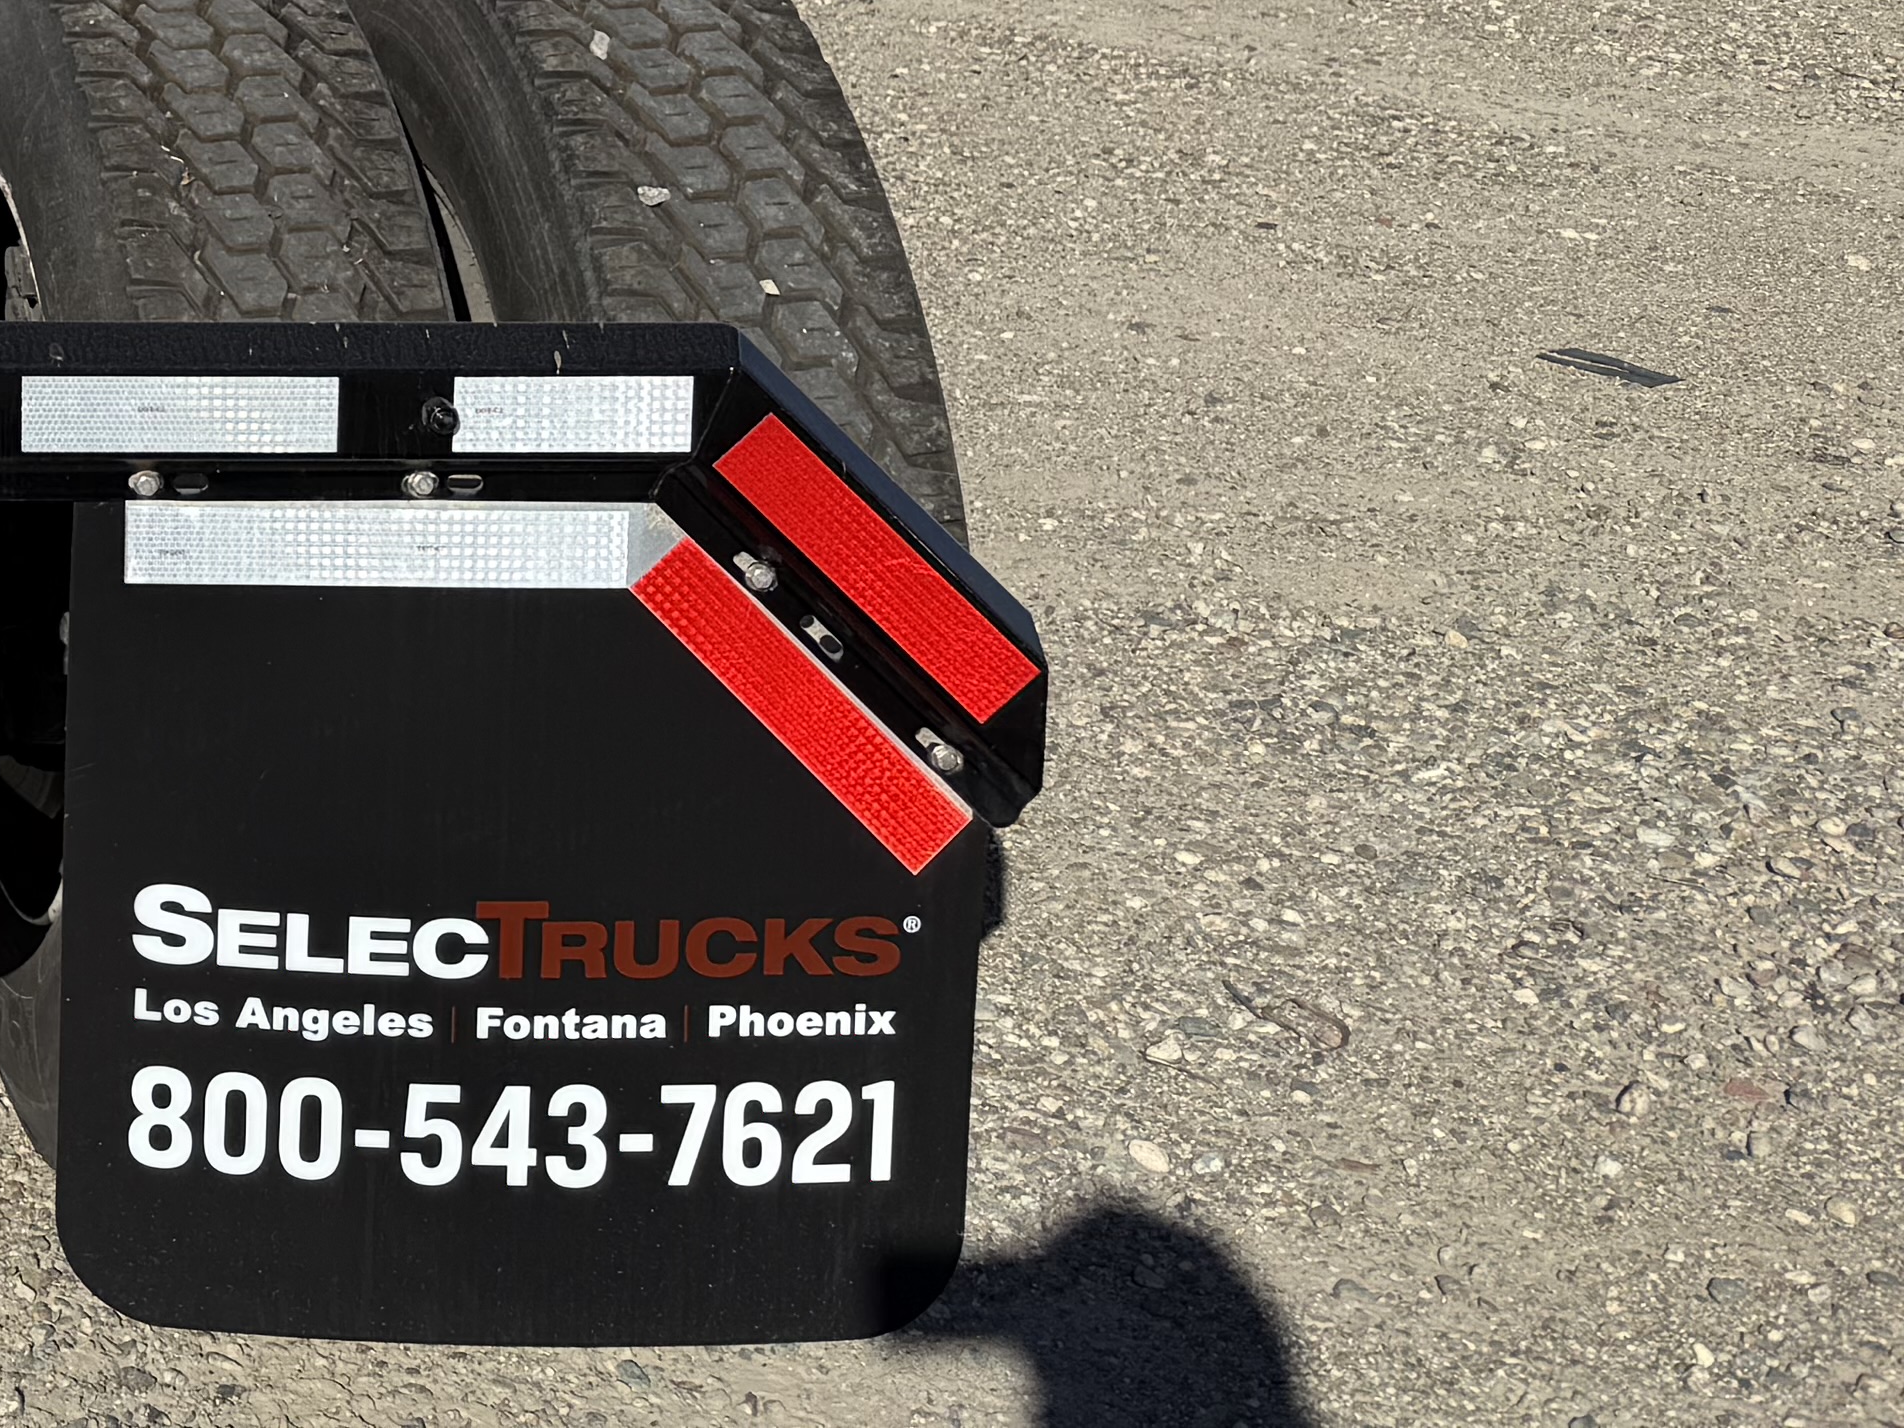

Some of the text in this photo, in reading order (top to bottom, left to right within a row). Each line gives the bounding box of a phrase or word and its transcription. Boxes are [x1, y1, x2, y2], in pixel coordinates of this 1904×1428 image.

[134, 988, 896, 1041] Los Angeles Fontana Phoenix
[128, 1066, 895, 1188] 800-543-7621
